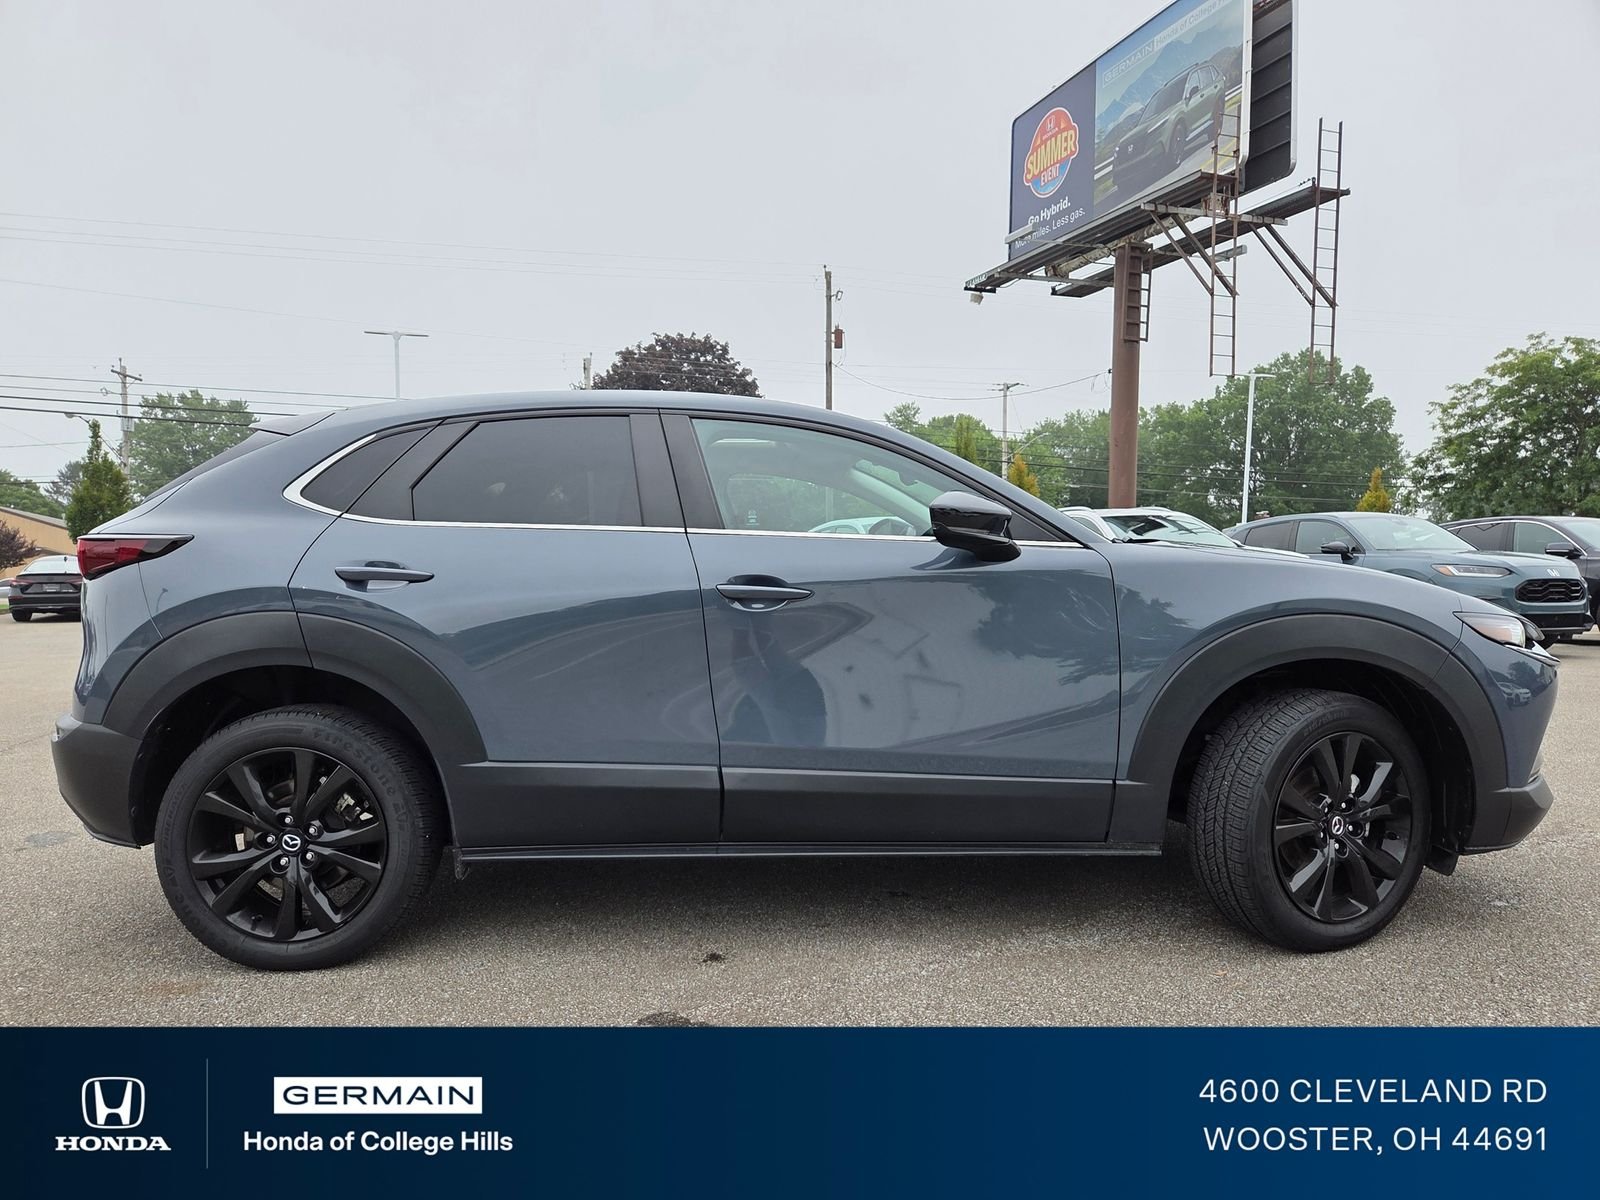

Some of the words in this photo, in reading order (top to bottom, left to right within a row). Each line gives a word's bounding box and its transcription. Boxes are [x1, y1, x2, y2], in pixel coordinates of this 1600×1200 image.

[1104, 41, 1153, 82] GERMAIN
[1026, 129, 1076, 180] SUMMER
[1040, 163, 1060, 186] EVENT
[1040, 196, 1071, 221] Hybrid.
[1052, 215, 1069, 230] Less
[1069, 207, 1086, 223] gas.
